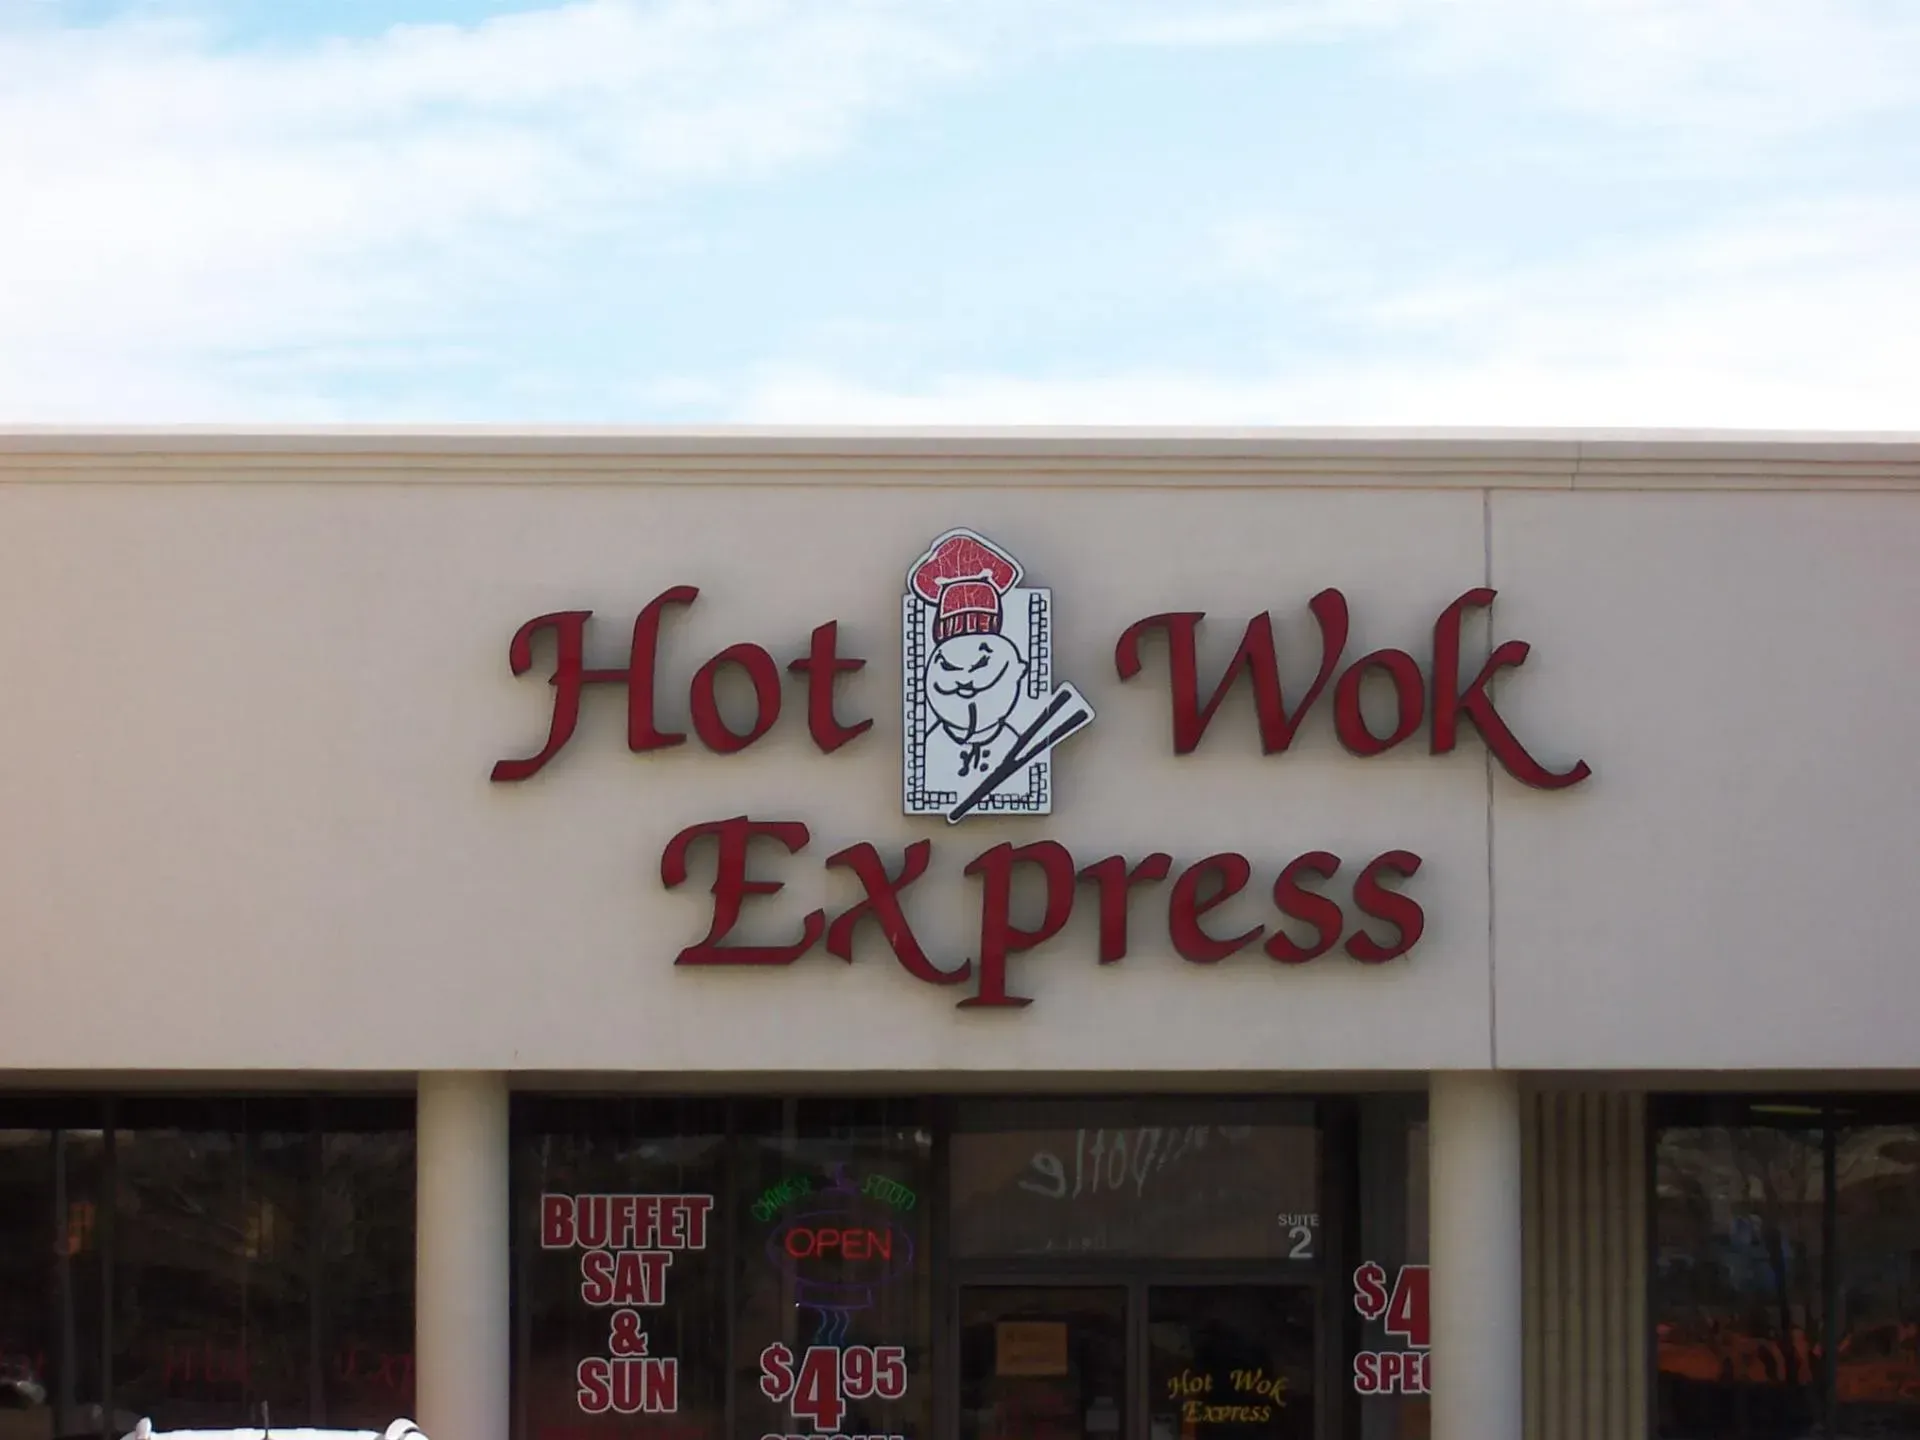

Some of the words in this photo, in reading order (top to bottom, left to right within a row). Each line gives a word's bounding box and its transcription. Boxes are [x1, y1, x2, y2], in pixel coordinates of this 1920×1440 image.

[490, 585, 873, 782] Hot
[1115, 587, 1592, 790] Wok
[661, 815, 1425, 1008] Express
[861, 1173, 917, 1212] FOOD
[541, 1194, 713, 1249] BUFFET
[1278, 1214, 1320, 1226] SUITE
[785, 1227, 892, 1260] OPEN
[1289, 1226, 1315, 1258] 2
[581, 1251, 672, 1305] SAT
[609, 1309, 648, 1357] &
[577, 1357, 678, 1413] SUN
[1167, 1368, 1213, 1399] Hot
[1230, 1368, 1289, 1407] Wok
[1182, 1400, 1271, 1423] Express
